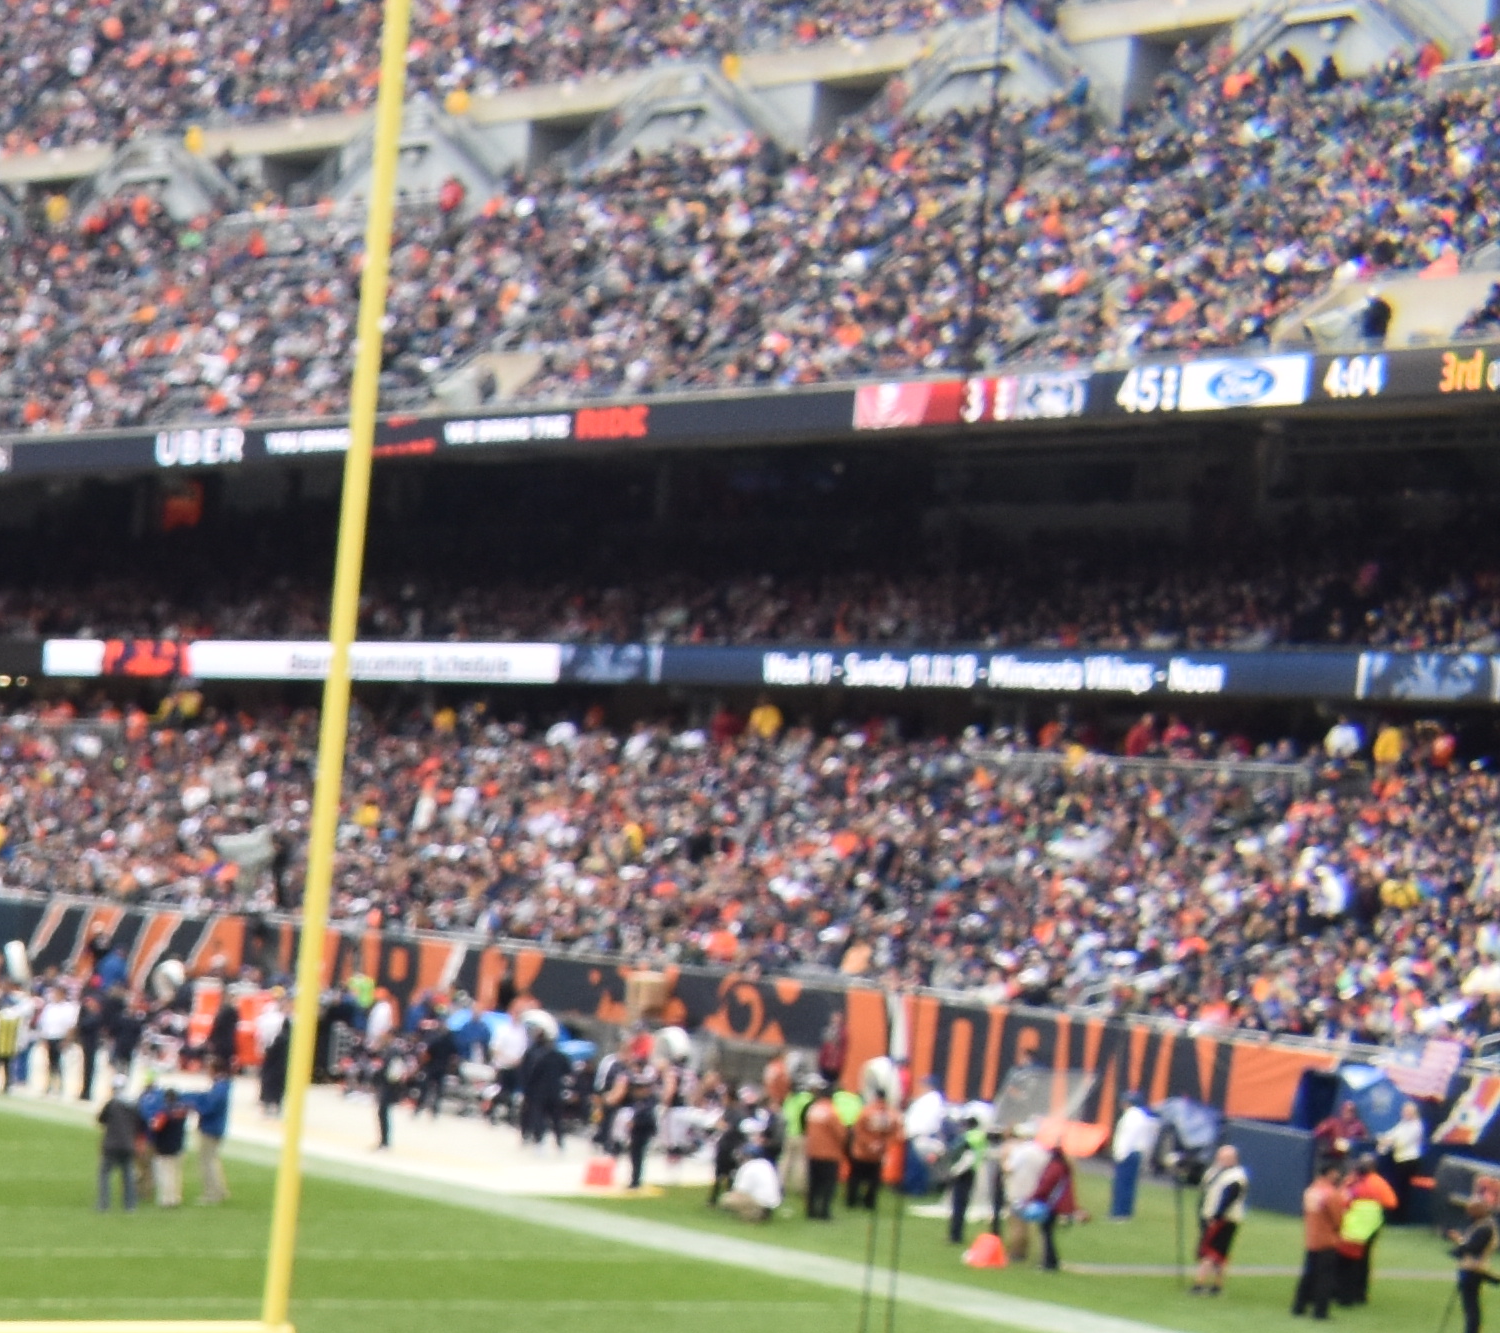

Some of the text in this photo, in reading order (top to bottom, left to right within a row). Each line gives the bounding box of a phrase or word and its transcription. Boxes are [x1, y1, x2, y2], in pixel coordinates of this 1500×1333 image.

[1116, 366, 1162, 413] 45
[1323, 354, 1388, 398] 4:04
[1439, 350, 1485, 392] 3rd
[154, 427, 245, 467] UBER
[763, 652, 810, 684] Week
[843, 653, 908, 690] Sunday
[988, 655, 1085, 690] Minnesota
[1084, 656, 1154, 694] Vikings
[1168, 657, 1225, 692] Noon
